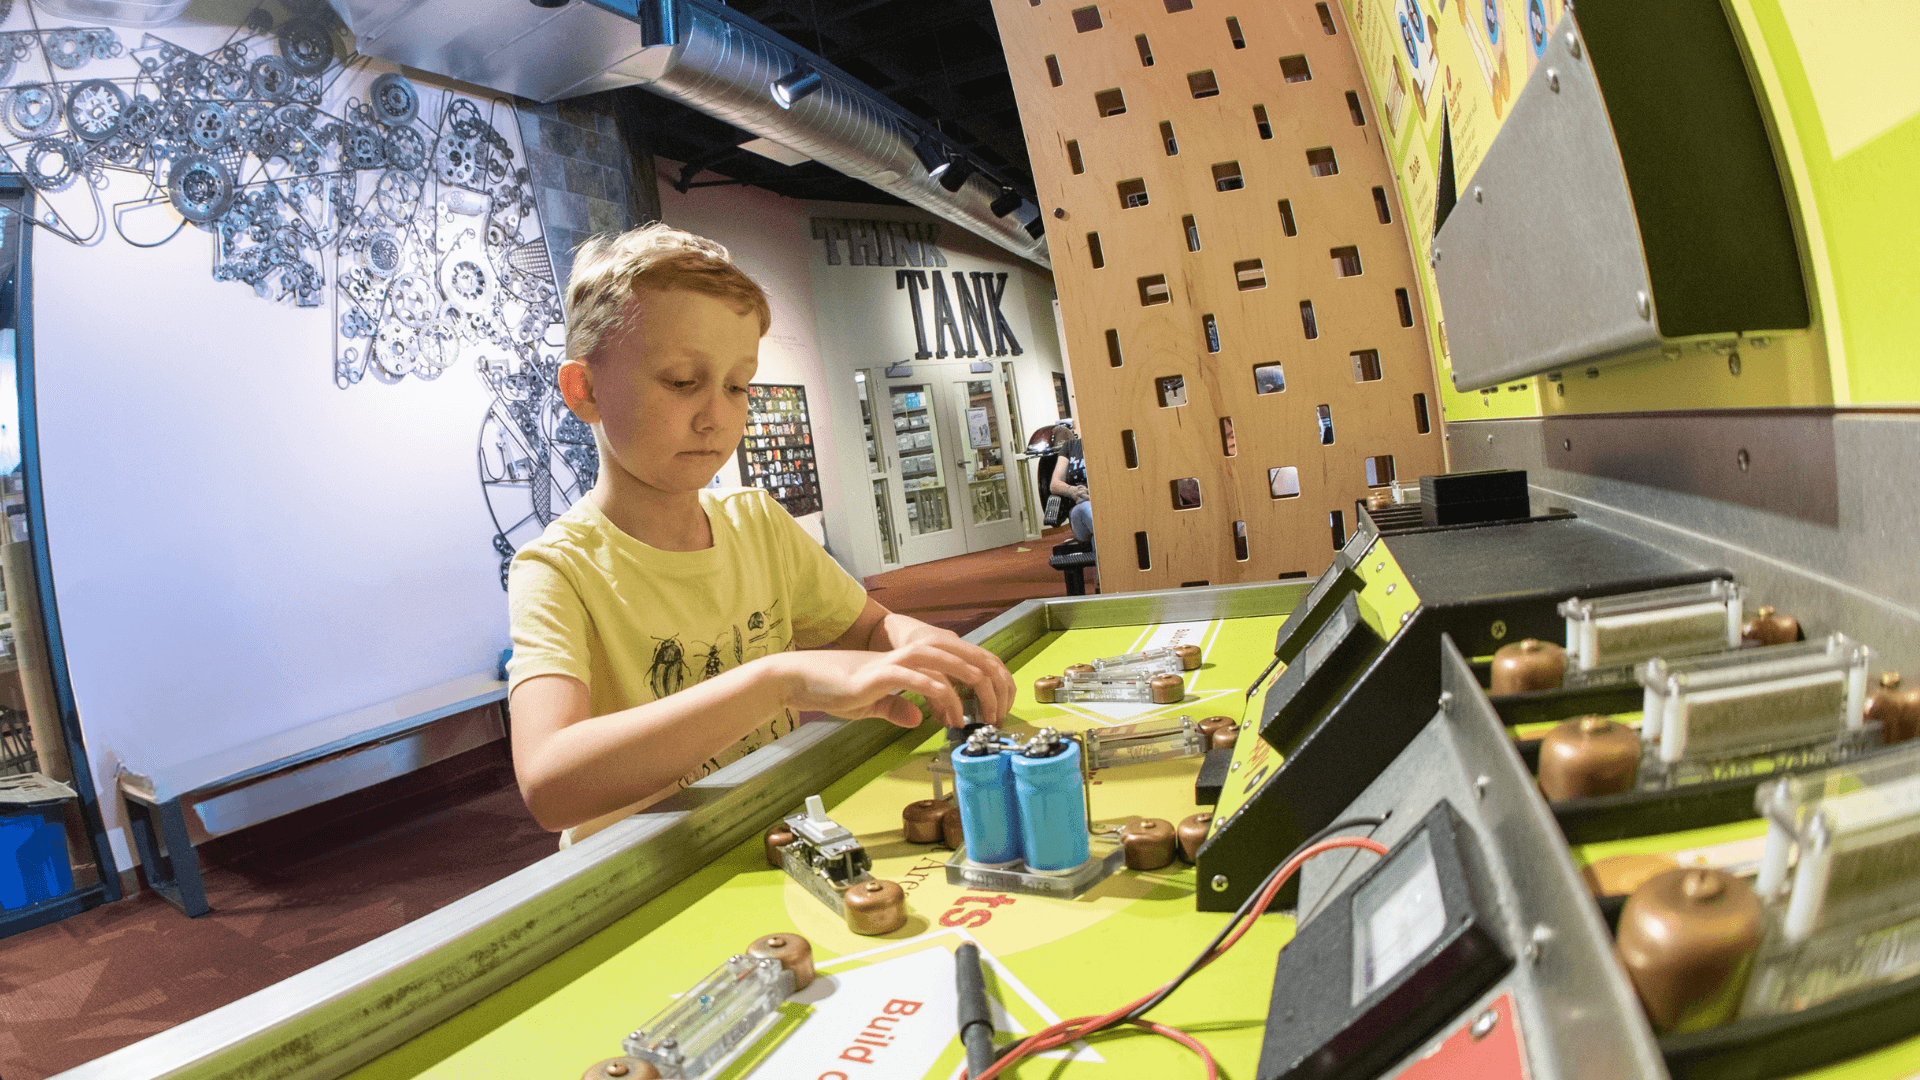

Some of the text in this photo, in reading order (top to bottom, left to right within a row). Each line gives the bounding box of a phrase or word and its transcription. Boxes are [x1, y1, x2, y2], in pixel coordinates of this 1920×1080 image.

[809, 216, 948, 268] THINK
[895, 269, 1024, 361] TANK
[896, 856, 947, 898] Are
[838, 998, 924, 1065] Build
